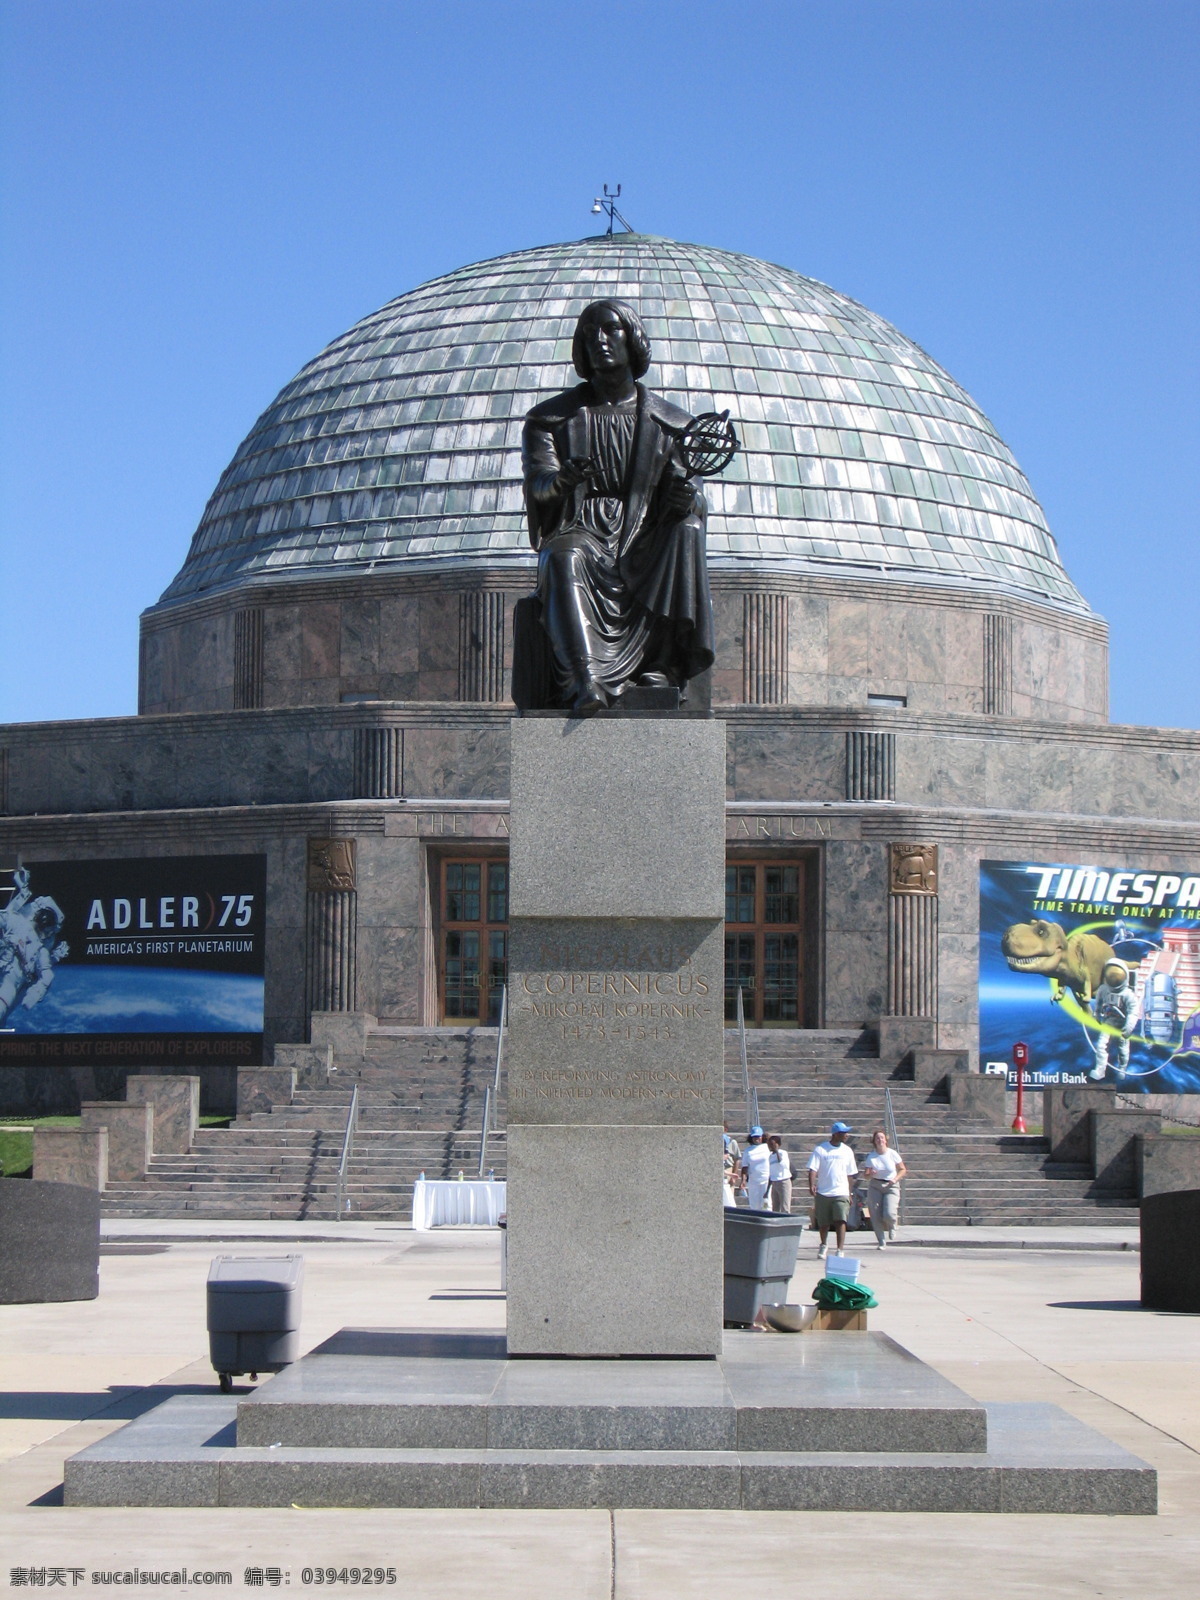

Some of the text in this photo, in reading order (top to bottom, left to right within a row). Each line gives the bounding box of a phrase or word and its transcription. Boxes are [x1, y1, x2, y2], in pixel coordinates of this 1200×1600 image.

[411, 813, 465, 834] THE
[87, 895, 254, 930] ADLER 75
[1033, 900, 1063, 912] TIME
[1070, 902, 1116, 916] TRAVEL
[1122, 905, 1154, 918] ONLY
[1159, 908, 1174, 919] AT
[87, 940, 253, 955] AMERICA'S FIRST PLANETARIUM
[540, 944, 693, 967] NICOLAUS
[522, 973, 709, 996] COPERNICUS
[39, 1041, 62, 1056] THE
[63, 1041, 94, 1056] NEXT
[95, 1040, 164, 1056] GENERATION
[168, 1040, 182, 1055] OF
[185, 1040, 252, 1055] EXPLORERS
[523, 1069, 708, 1082] BY REFORMING ASTRONOMY
[1008, 1071, 1088, 1084] Fith Third Bank
[535, 1087, 593, 1099] INITIATED
[600, 1087, 657, 1099] MODERN
[662, 1087, 715, 1100] SCIENCE
